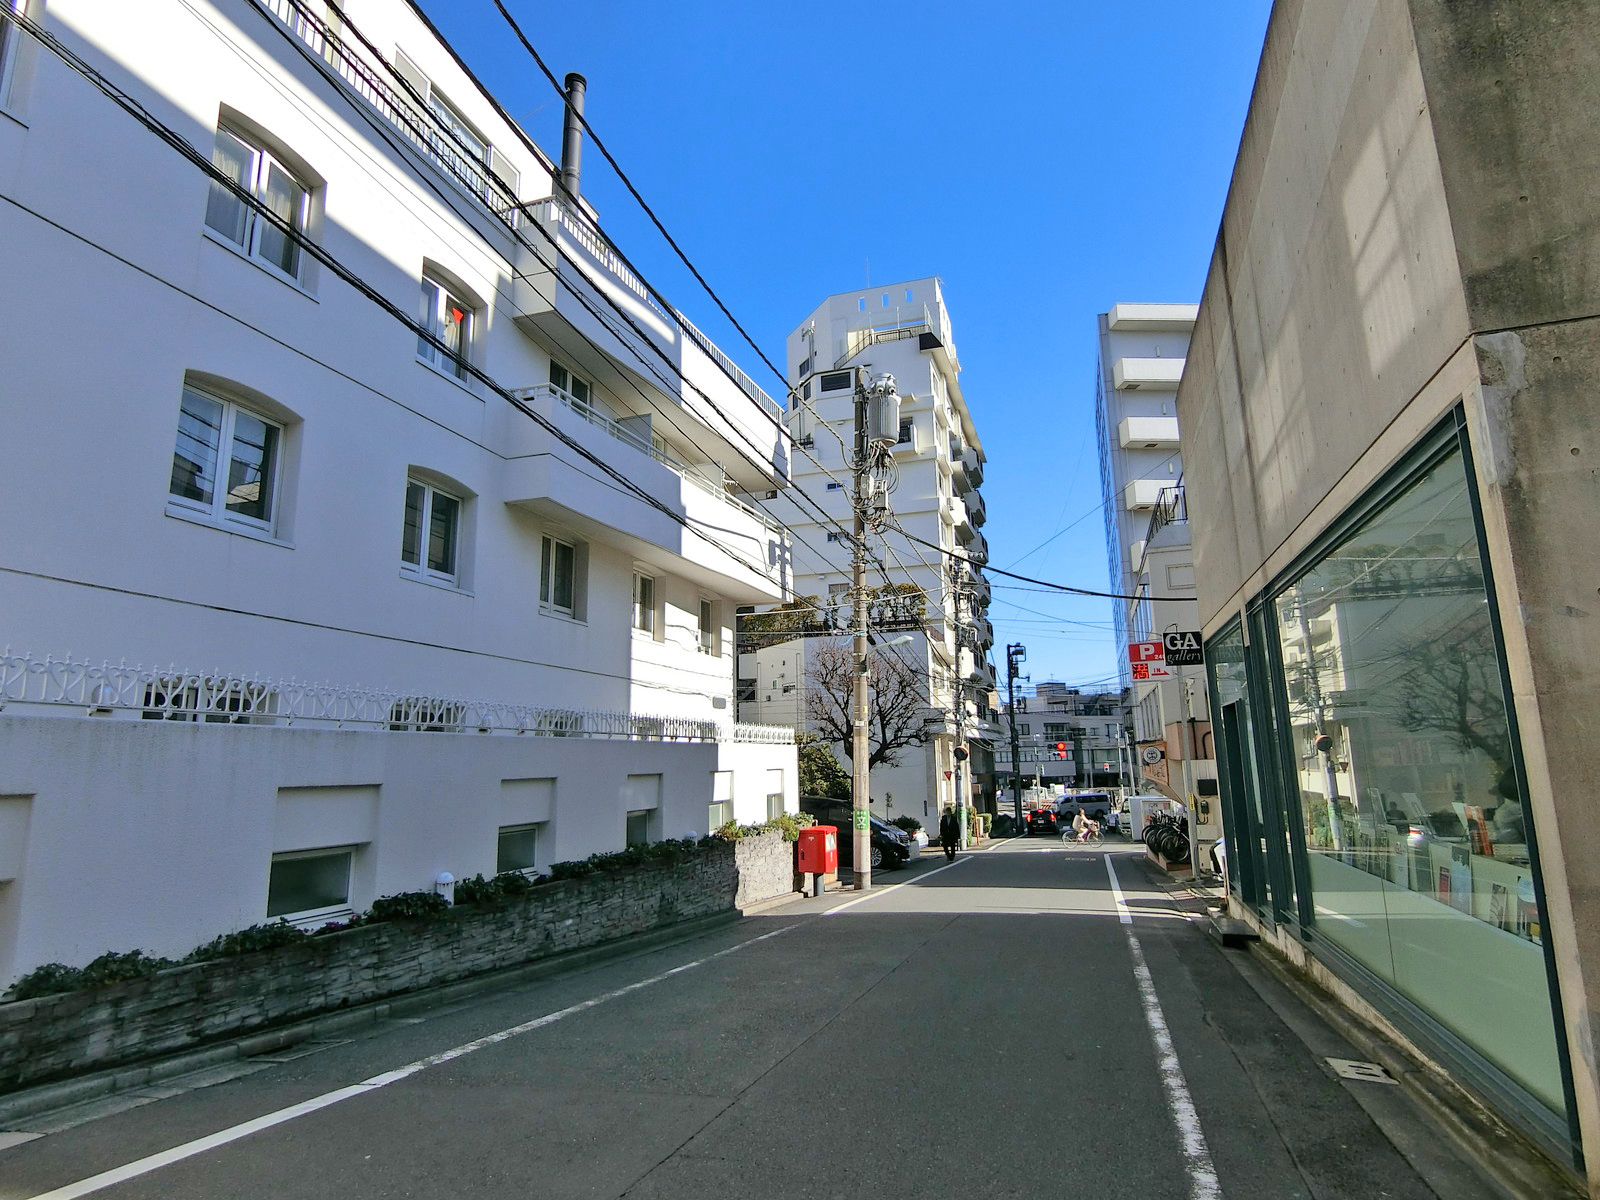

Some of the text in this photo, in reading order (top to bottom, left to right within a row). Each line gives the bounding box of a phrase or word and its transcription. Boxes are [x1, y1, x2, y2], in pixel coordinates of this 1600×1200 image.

[1165, 633, 1200, 650] GA
[1139, 644, 1154, 660] P
[1132, 664, 1149, 680] 満
